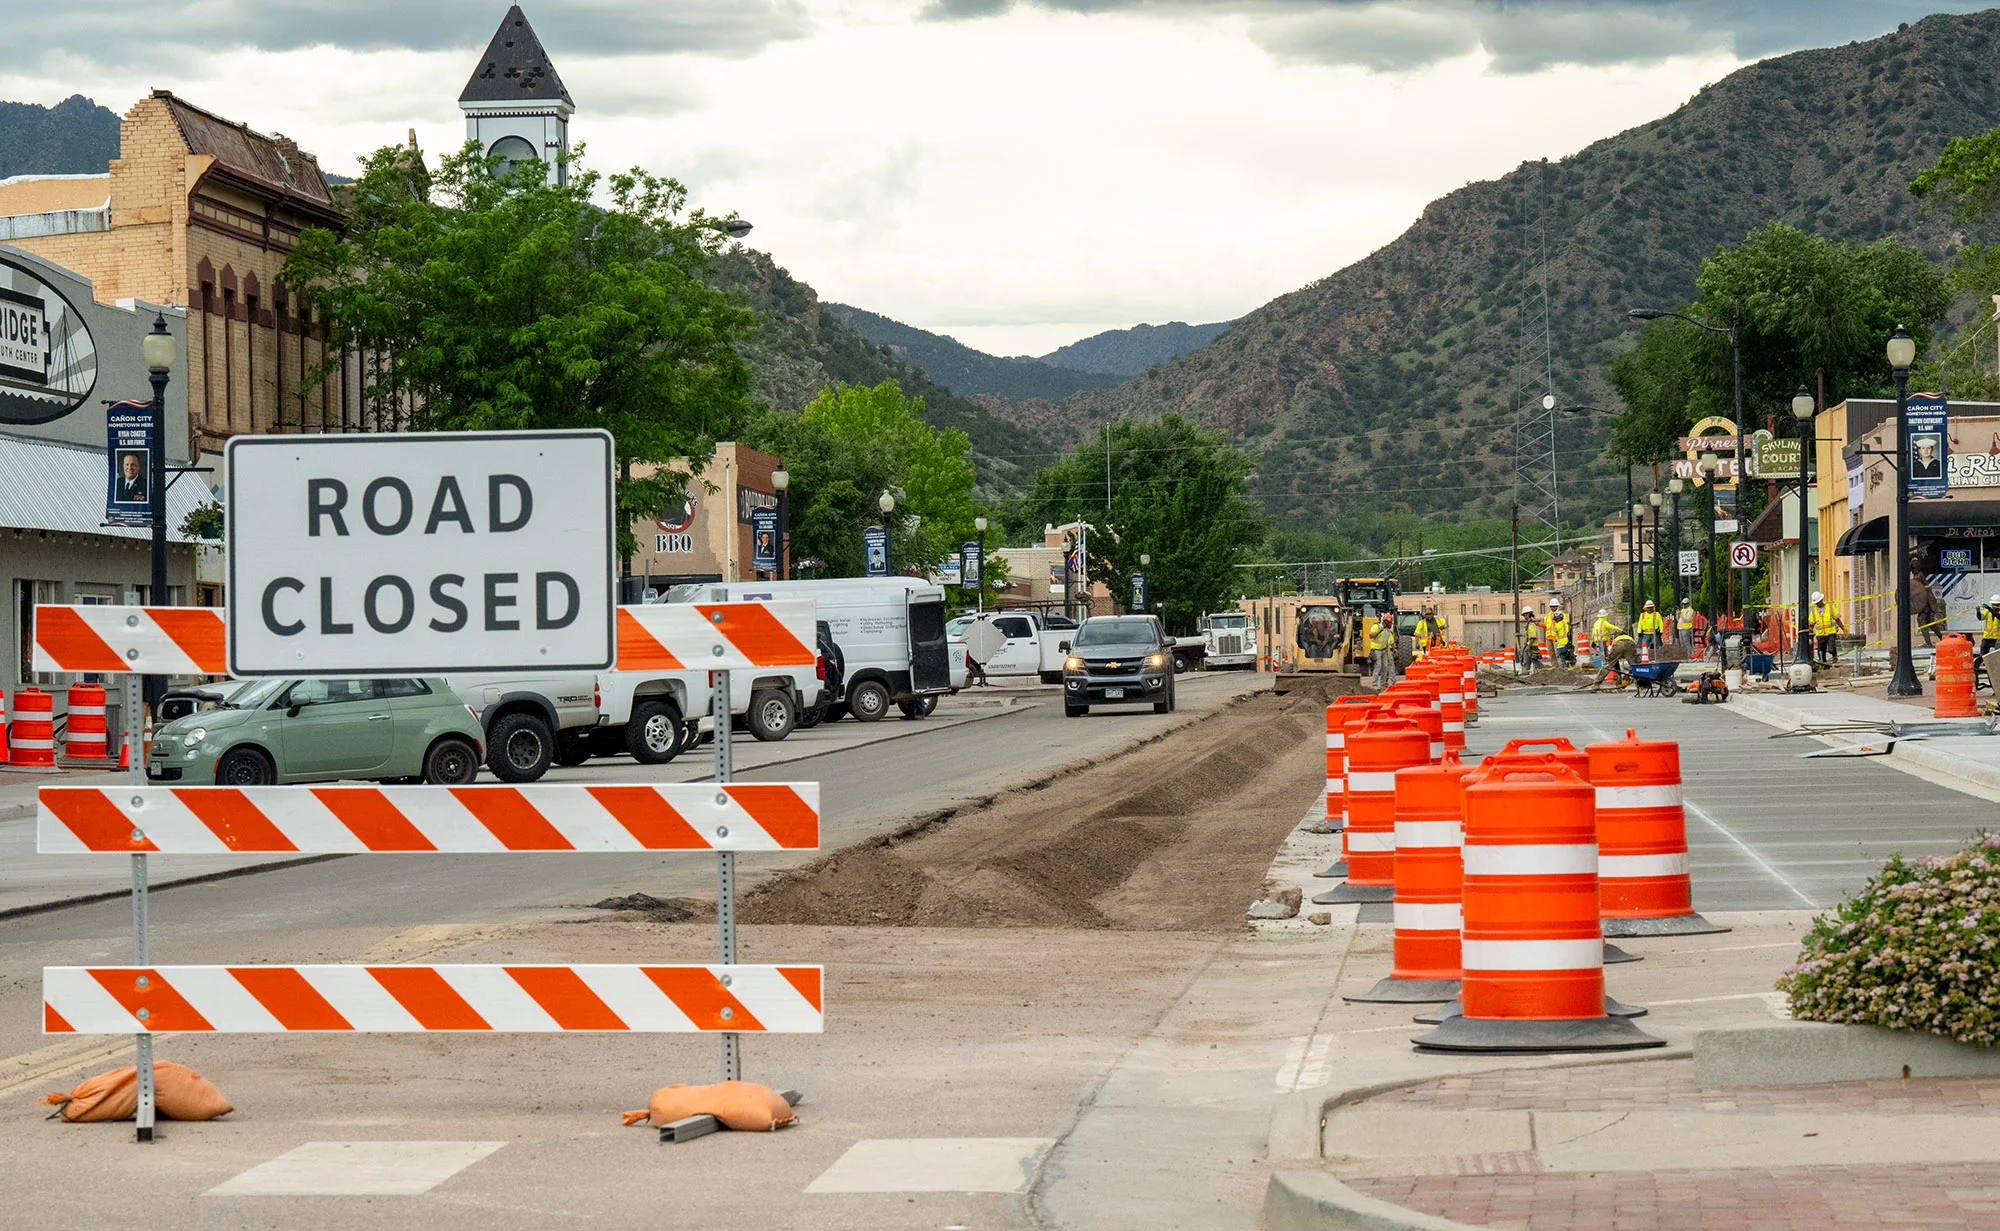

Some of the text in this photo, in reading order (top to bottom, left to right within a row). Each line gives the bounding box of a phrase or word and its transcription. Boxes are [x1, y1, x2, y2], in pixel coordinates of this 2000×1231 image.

[15, 349, 38, 364] CENTER
[307, 473, 534, 538] ROAD
[655, 534, 694, 553] BBQ
[1682, 562, 1698, 572] 25
[1943, 558, 1969, 566] LIGHT
[261, 571, 581, 637] CLOSED
